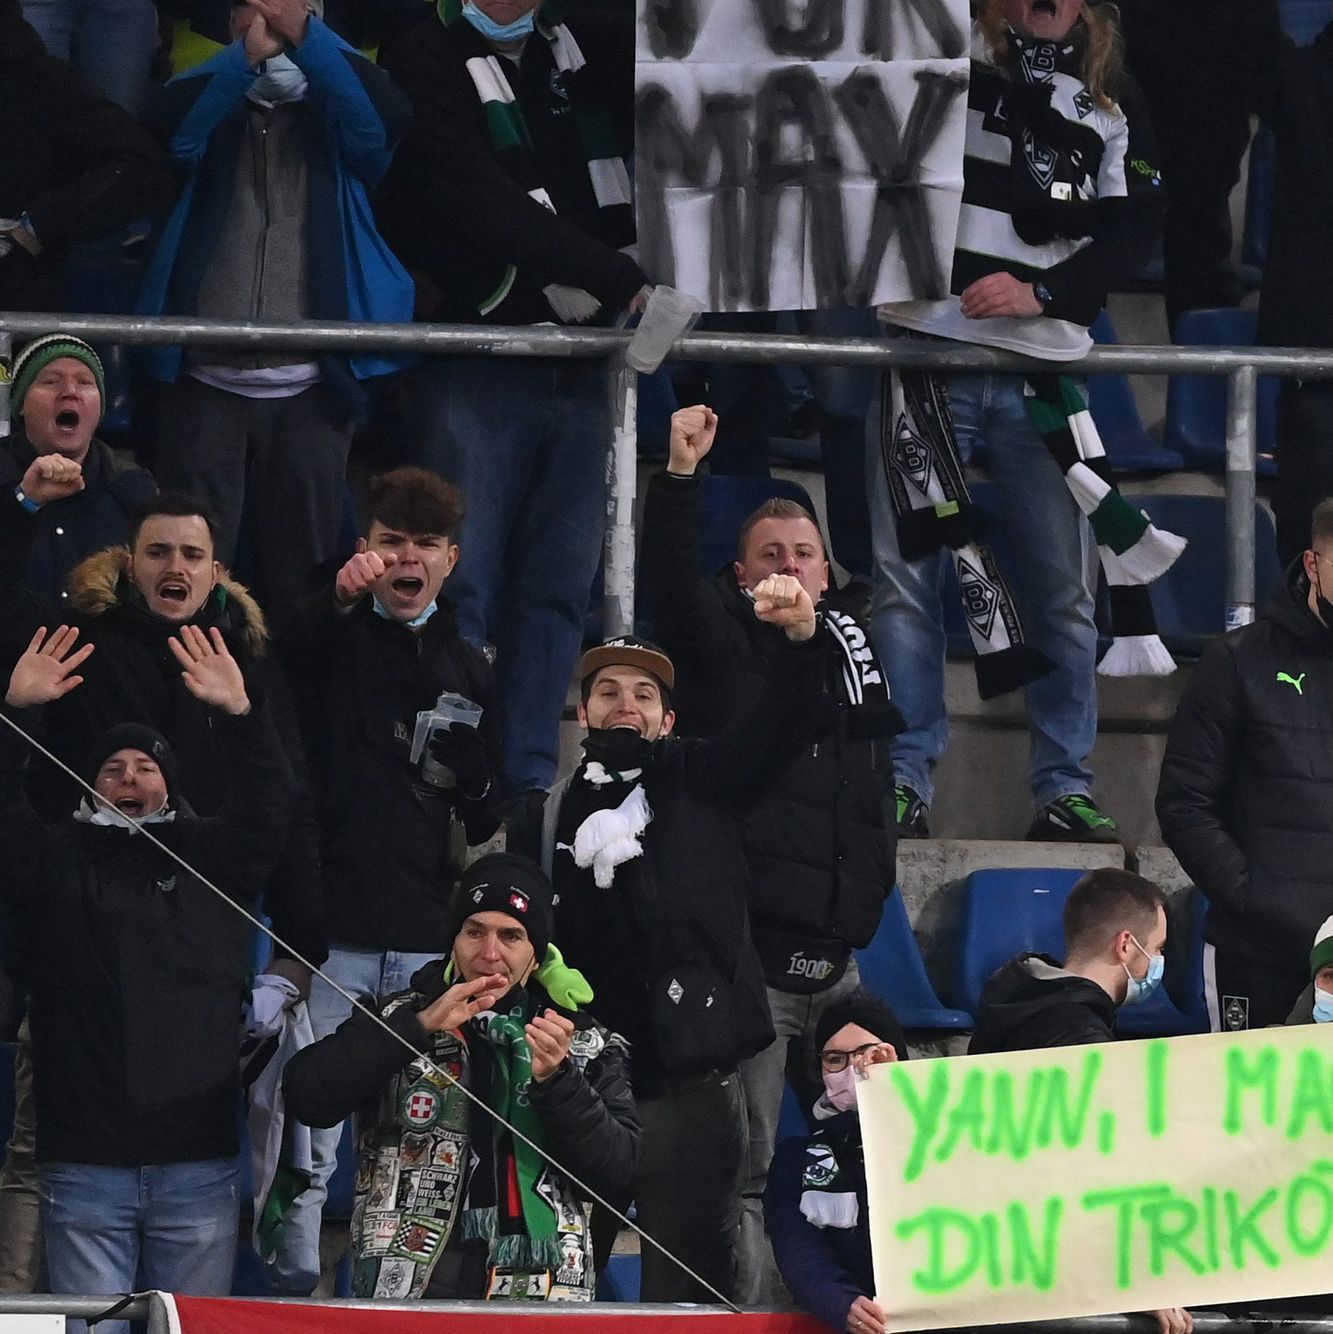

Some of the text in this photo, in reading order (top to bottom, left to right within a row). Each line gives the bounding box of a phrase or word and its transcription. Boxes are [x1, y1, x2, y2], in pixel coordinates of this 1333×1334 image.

[636, 65, 969, 311] MAX
[891, 1047, 1115, 1182] YANN,
[1146, 1038, 1170, 1136] I
[897, 1196, 1065, 1294] DIN
